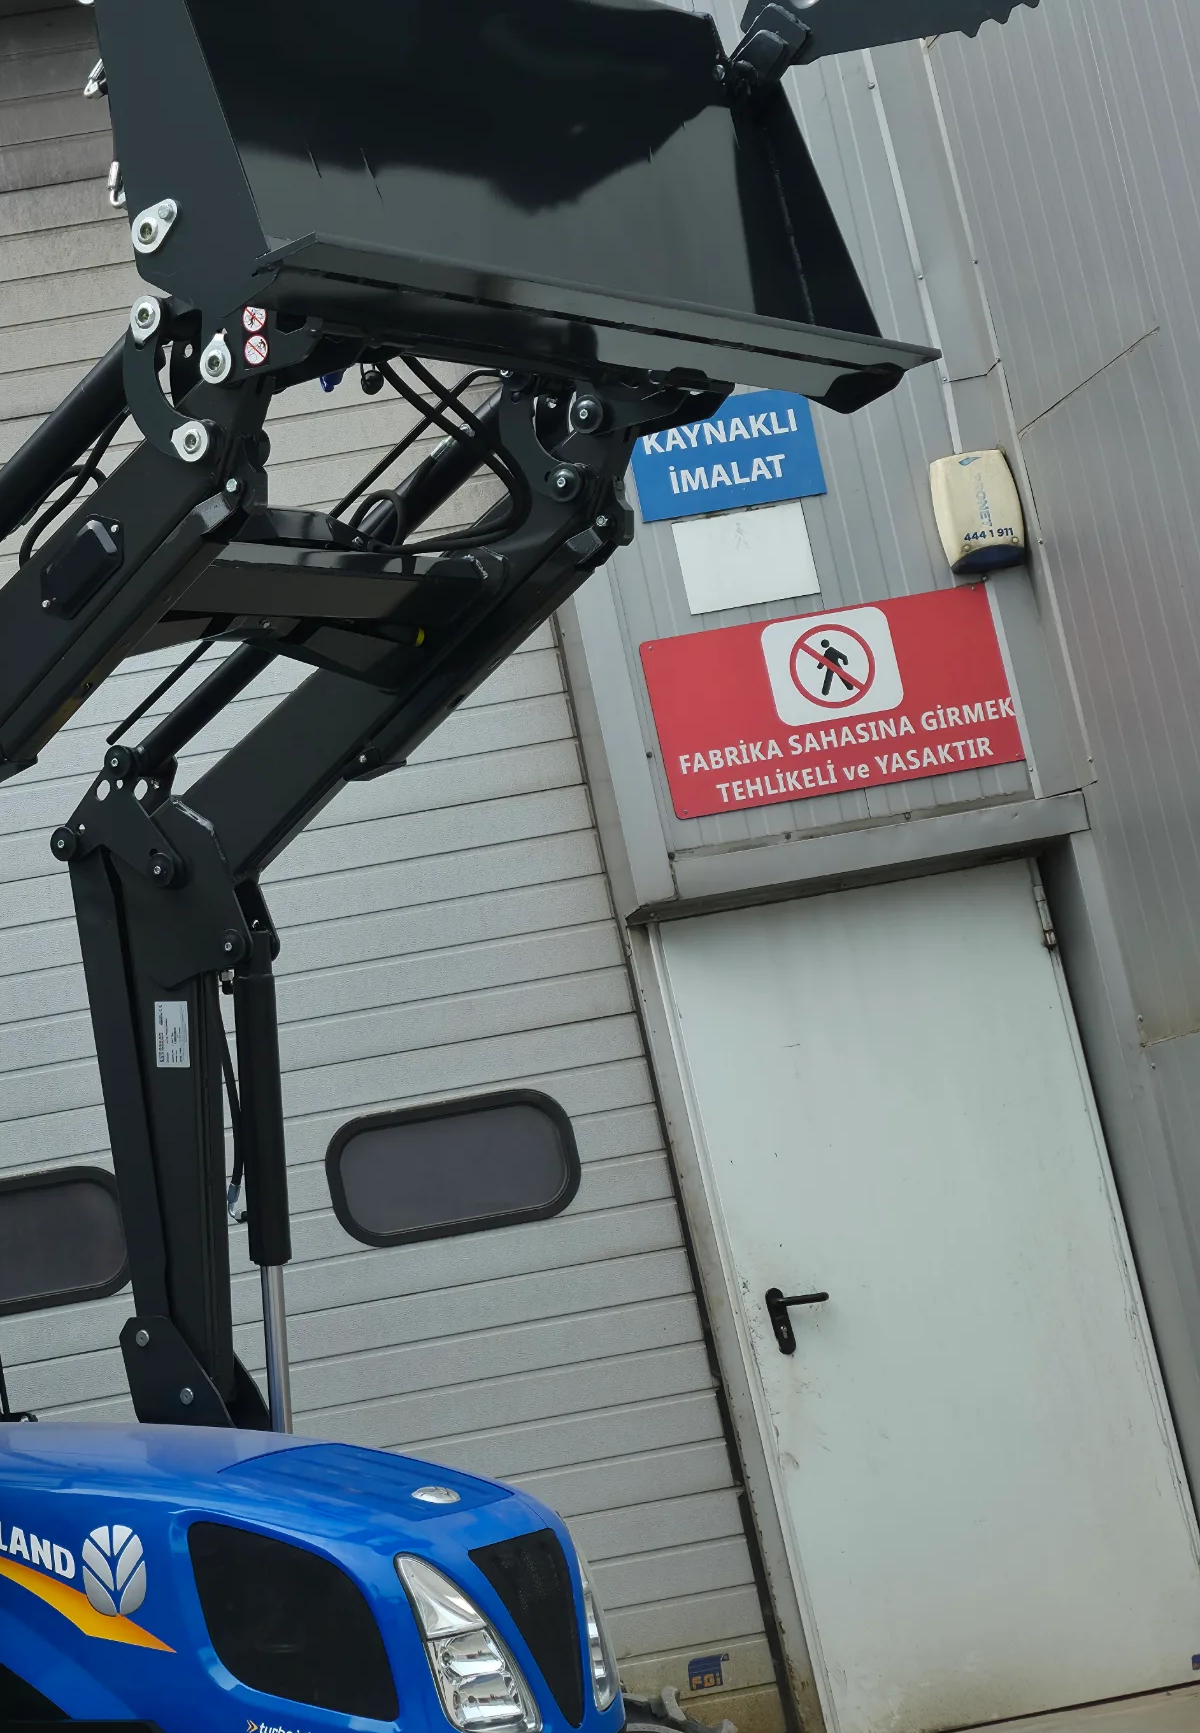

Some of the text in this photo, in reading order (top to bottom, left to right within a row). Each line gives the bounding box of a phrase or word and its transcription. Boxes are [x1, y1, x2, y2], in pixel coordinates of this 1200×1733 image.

[642, 408, 798, 455] KAYNAKLI
[669, 454, 786, 495] İMALAT
[964, 527, 1014, 541] 444 1 911
[679, 696, 1016, 775] FABRİKA SAHASINA GİRMEK
[716, 737, 995, 803] TEHLİKELİ ve YASAKTIR
